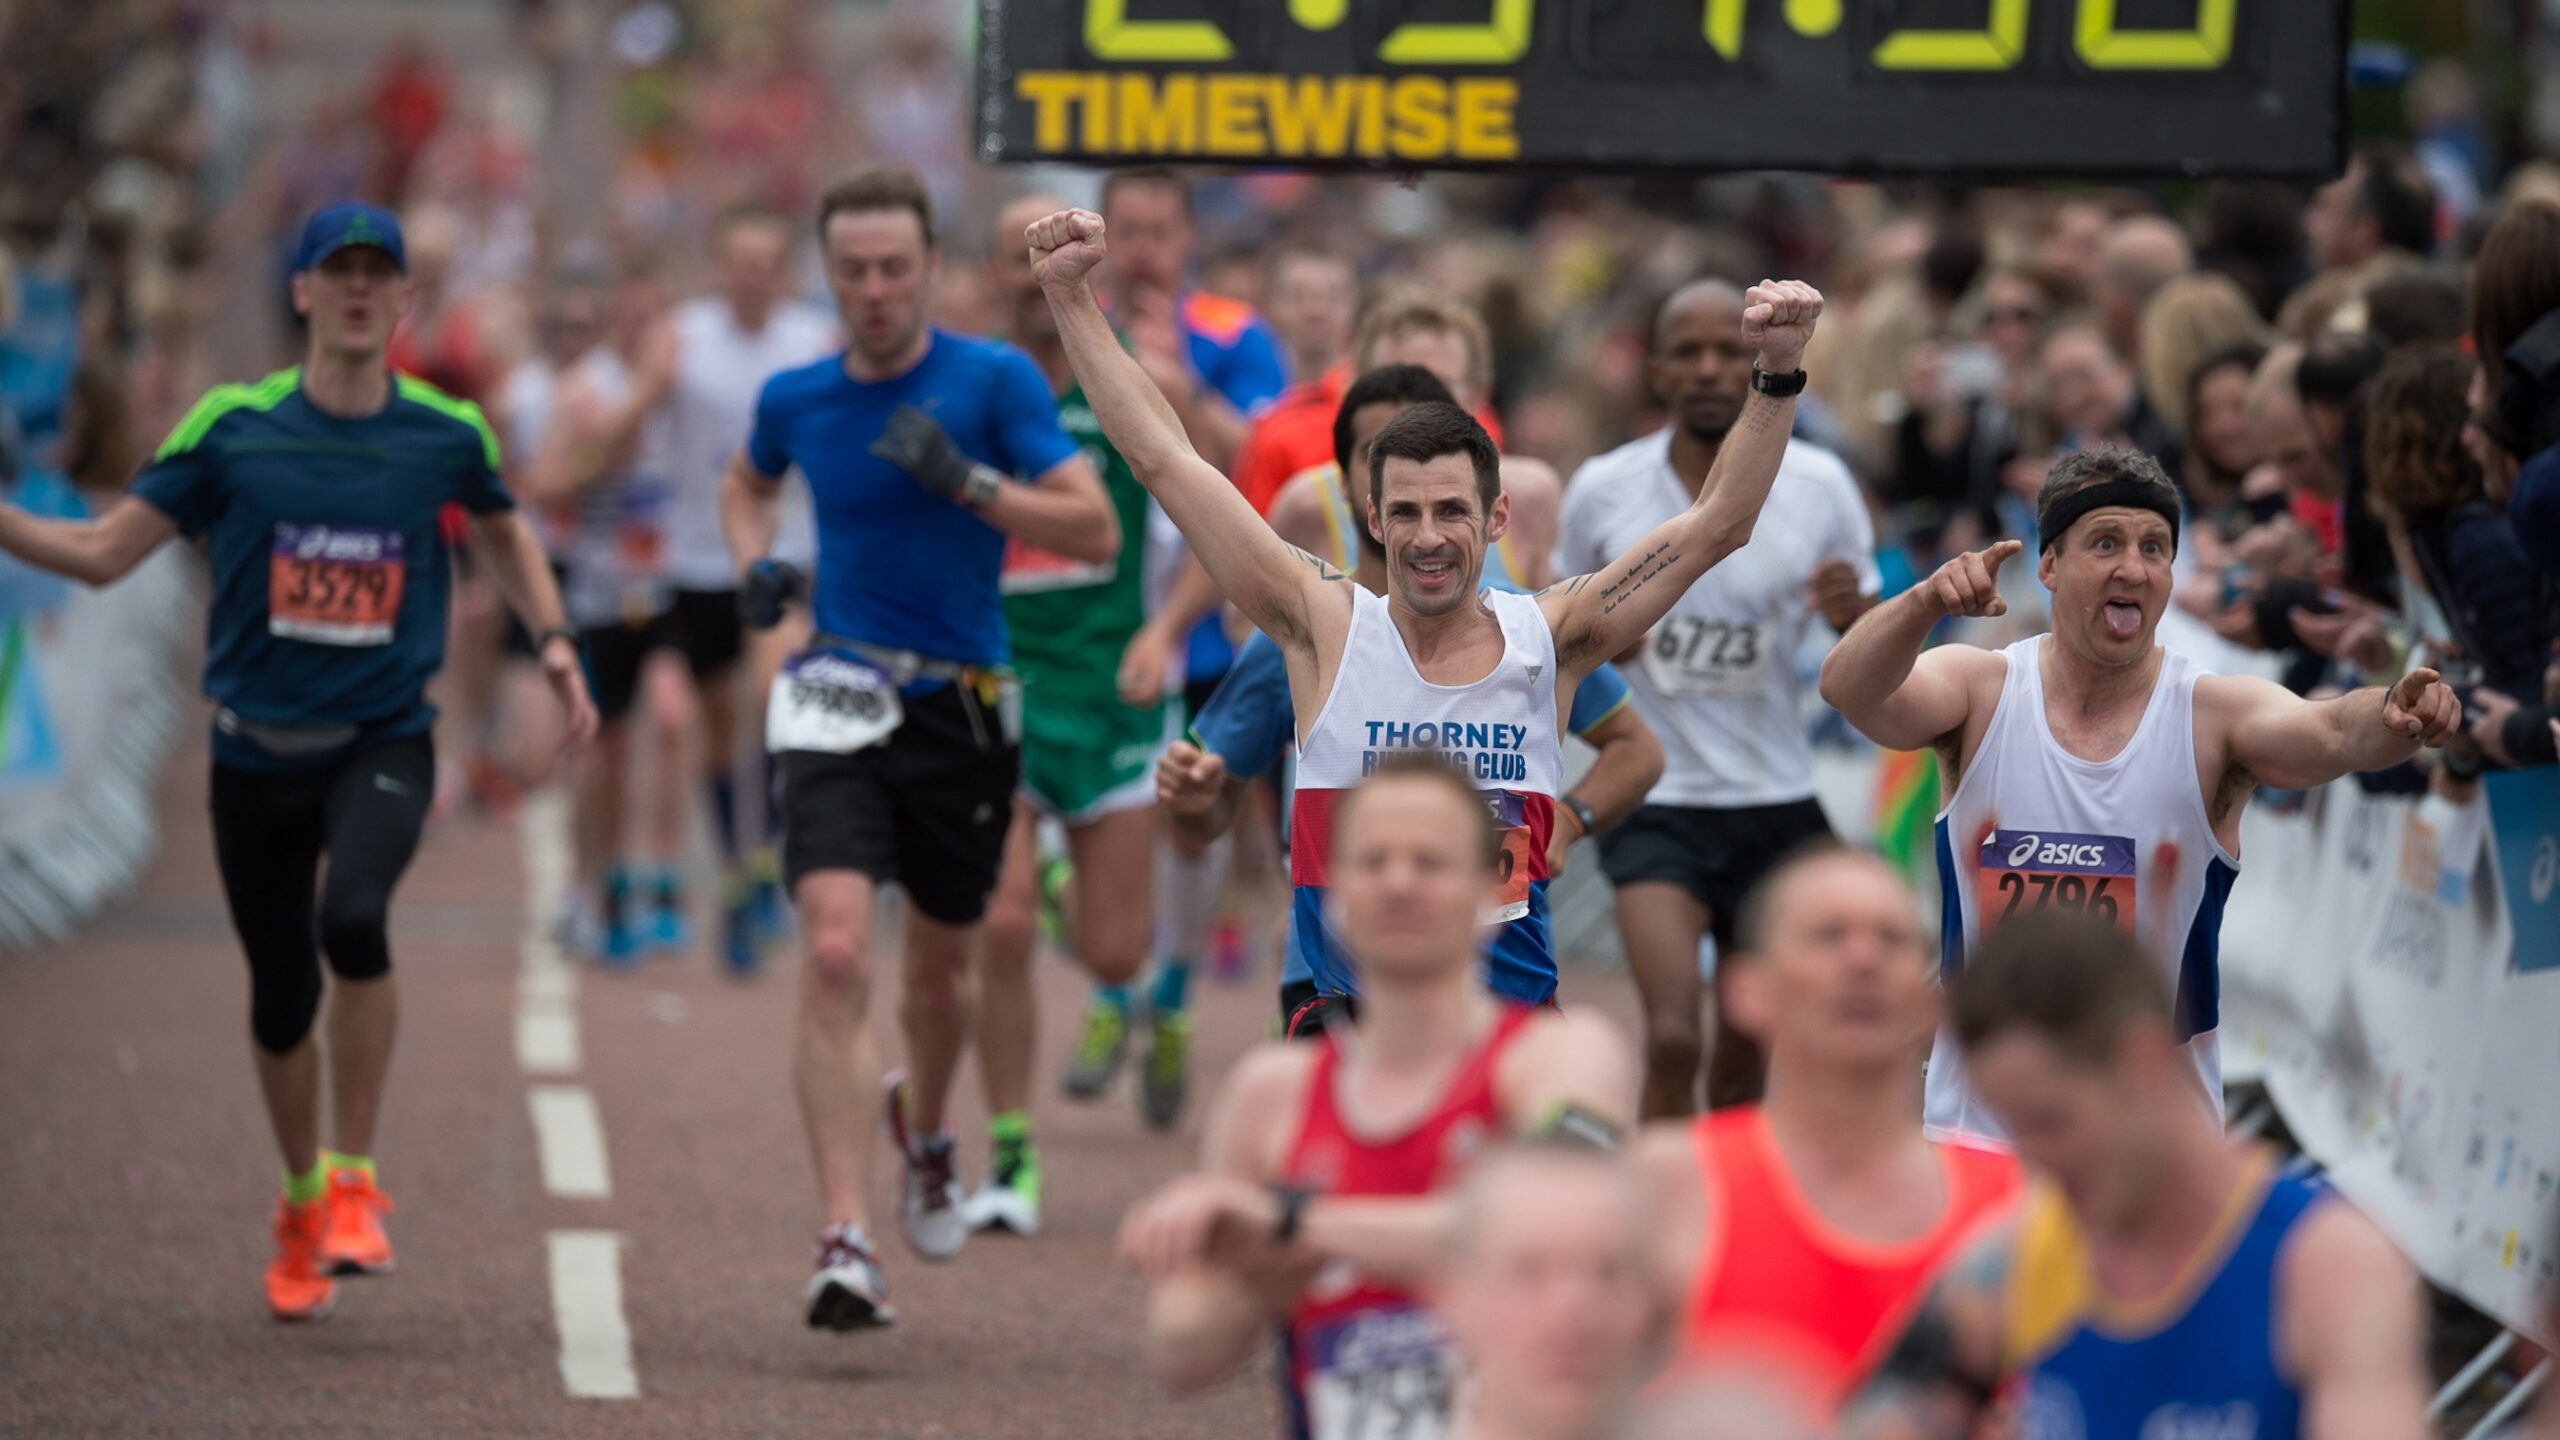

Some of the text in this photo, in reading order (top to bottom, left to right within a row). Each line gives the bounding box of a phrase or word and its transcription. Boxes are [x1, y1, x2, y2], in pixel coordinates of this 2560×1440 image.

[1017, 71, 1520, 160] TIMEWISE
[288, 561, 387, 611] 3529
[1656, 615, 1759, 670] 6723
[1365, 721, 1527, 751] THORNEY
[1361, 750, 1526, 781] RUING CLUB
[2037, 842, 2106, 867] asics
[1998, 872, 2118, 926] 2796
